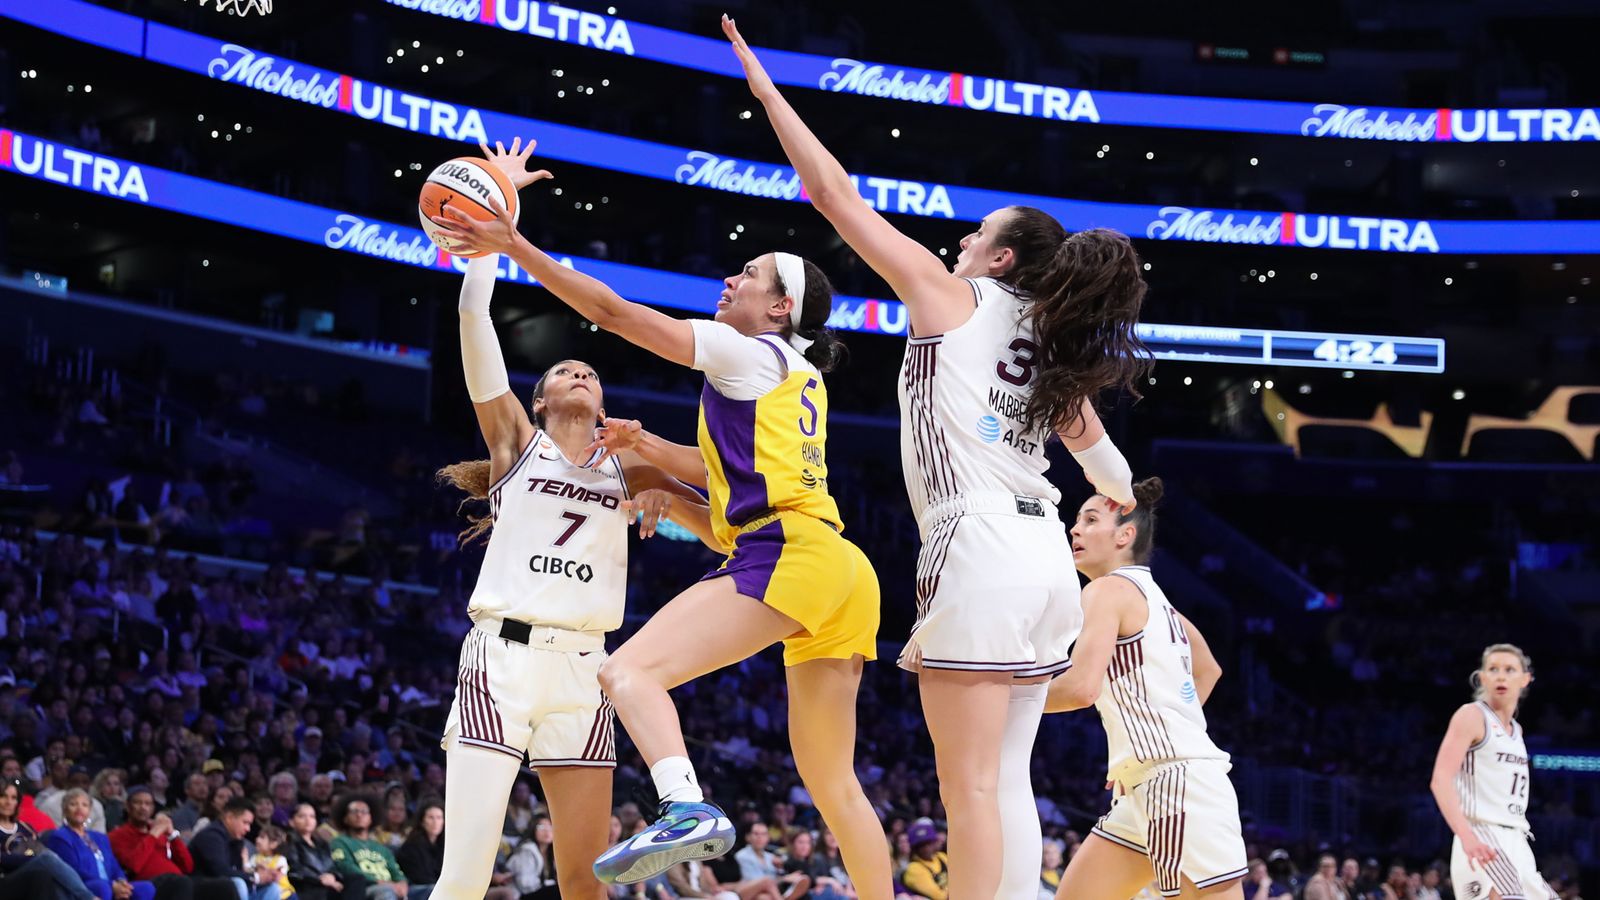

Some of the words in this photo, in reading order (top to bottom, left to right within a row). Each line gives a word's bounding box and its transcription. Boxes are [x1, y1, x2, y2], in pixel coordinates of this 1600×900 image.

[495, 0, 635, 55] ULTRA
[208, 44, 339, 108] Michelob
[352, 80, 489, 145] ULTRA
[818, 58, 951, 104] Michelob
[962, 75, 1100, 123] ULTRA
[1301, 104, 1438, 142] Michelob
[1451, 108, 1600, 142] ULTRA
[12, 129, 149, 202] ULTRA
[436, 163, 491, 200] Wilson
[675, 150, 801, 201] Michelob
[324, 213, 438, 267] Michelob
[1146, 206, 1282, 245] Michelob
[1295, 214, 1440, 253] ULTRA
[996, 337, 1037, 387] 3
[1313, 339, 1398, 365] 4:24
[799, 377, 818, 437] 5
[989, 386, 1030, 425] MABRE
[527, 478, 620, 510] TEMPO
[552, 511, 590, 547] 7
[529, 555, 576, 578] CIBC
[1511, 773, 1526, 798] 12
[1508, 803, 1524, 816] CIB
